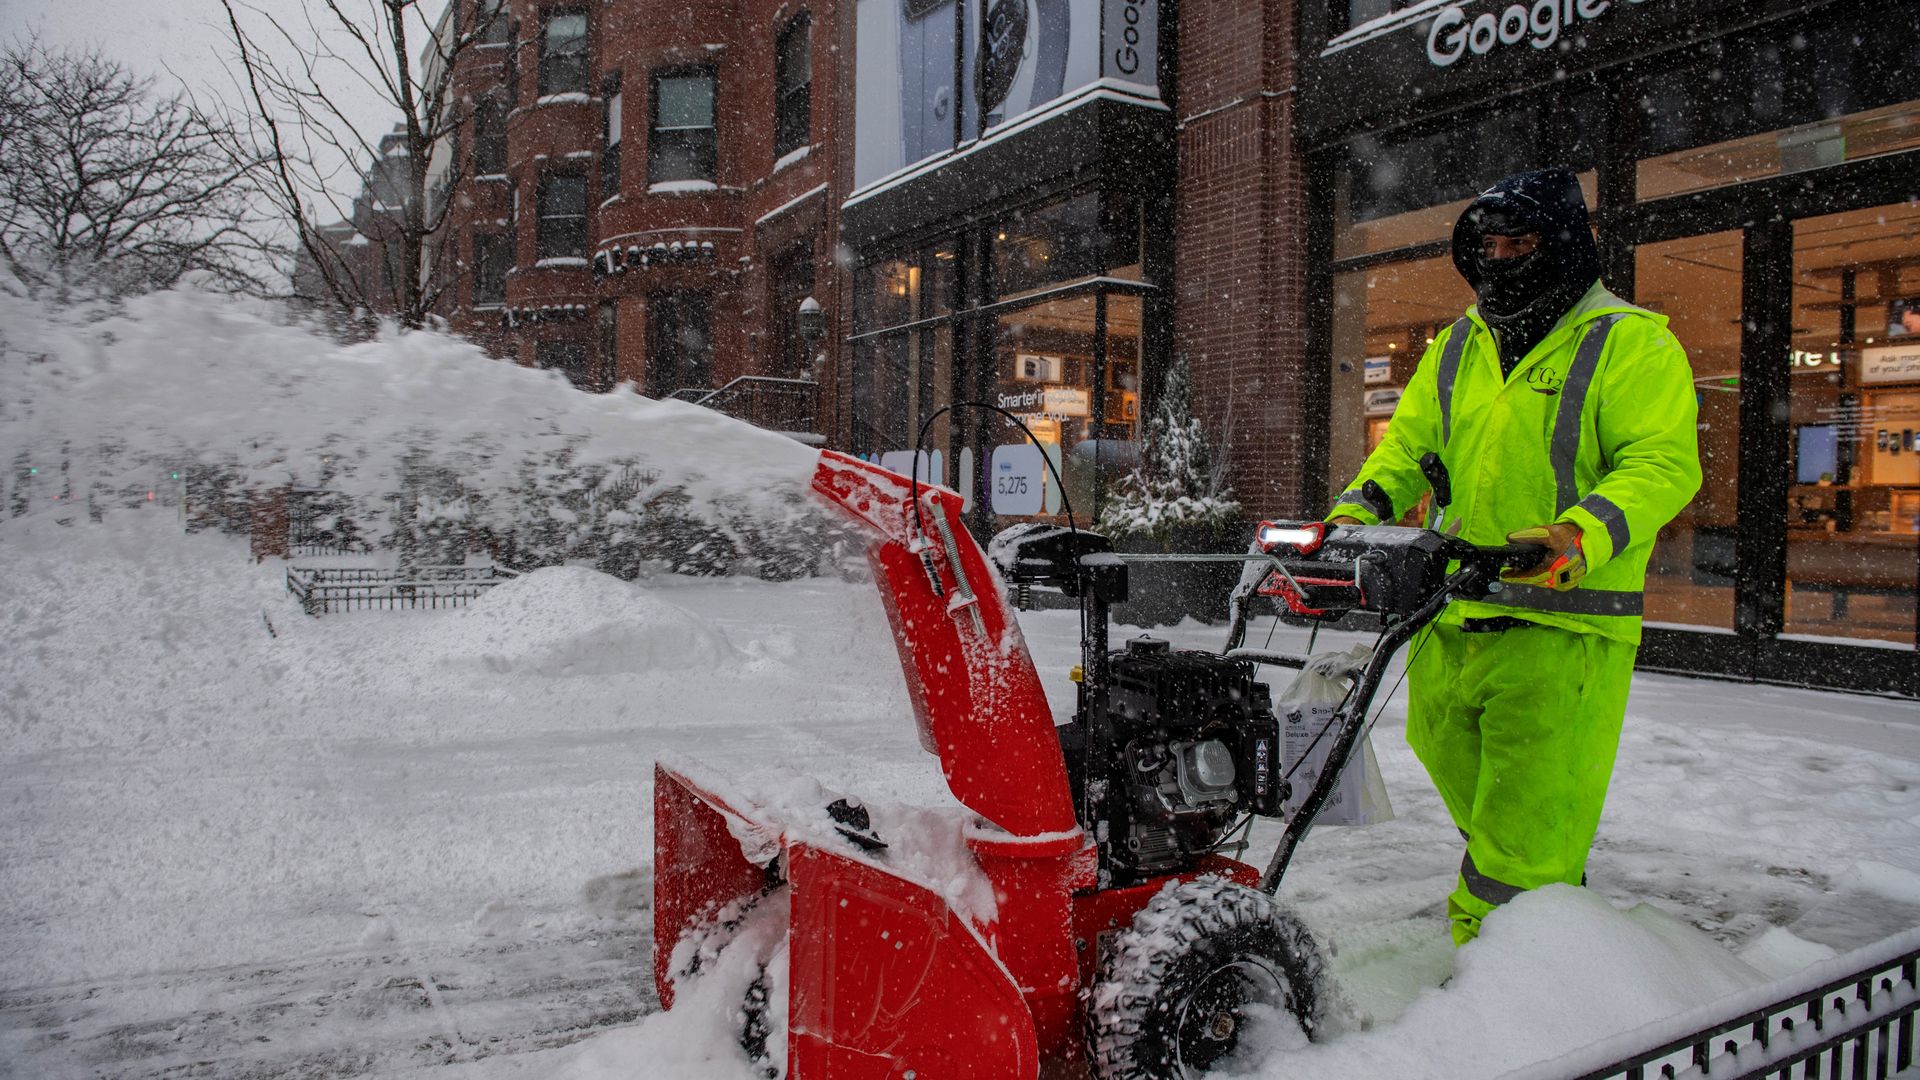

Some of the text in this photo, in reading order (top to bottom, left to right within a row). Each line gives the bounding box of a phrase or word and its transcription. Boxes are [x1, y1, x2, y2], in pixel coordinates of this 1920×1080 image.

[1115, 0, 1146, 75] Goo
[997, 391, 1037, 409] Smarter
[998, 476, 1028, 496] 5,275
